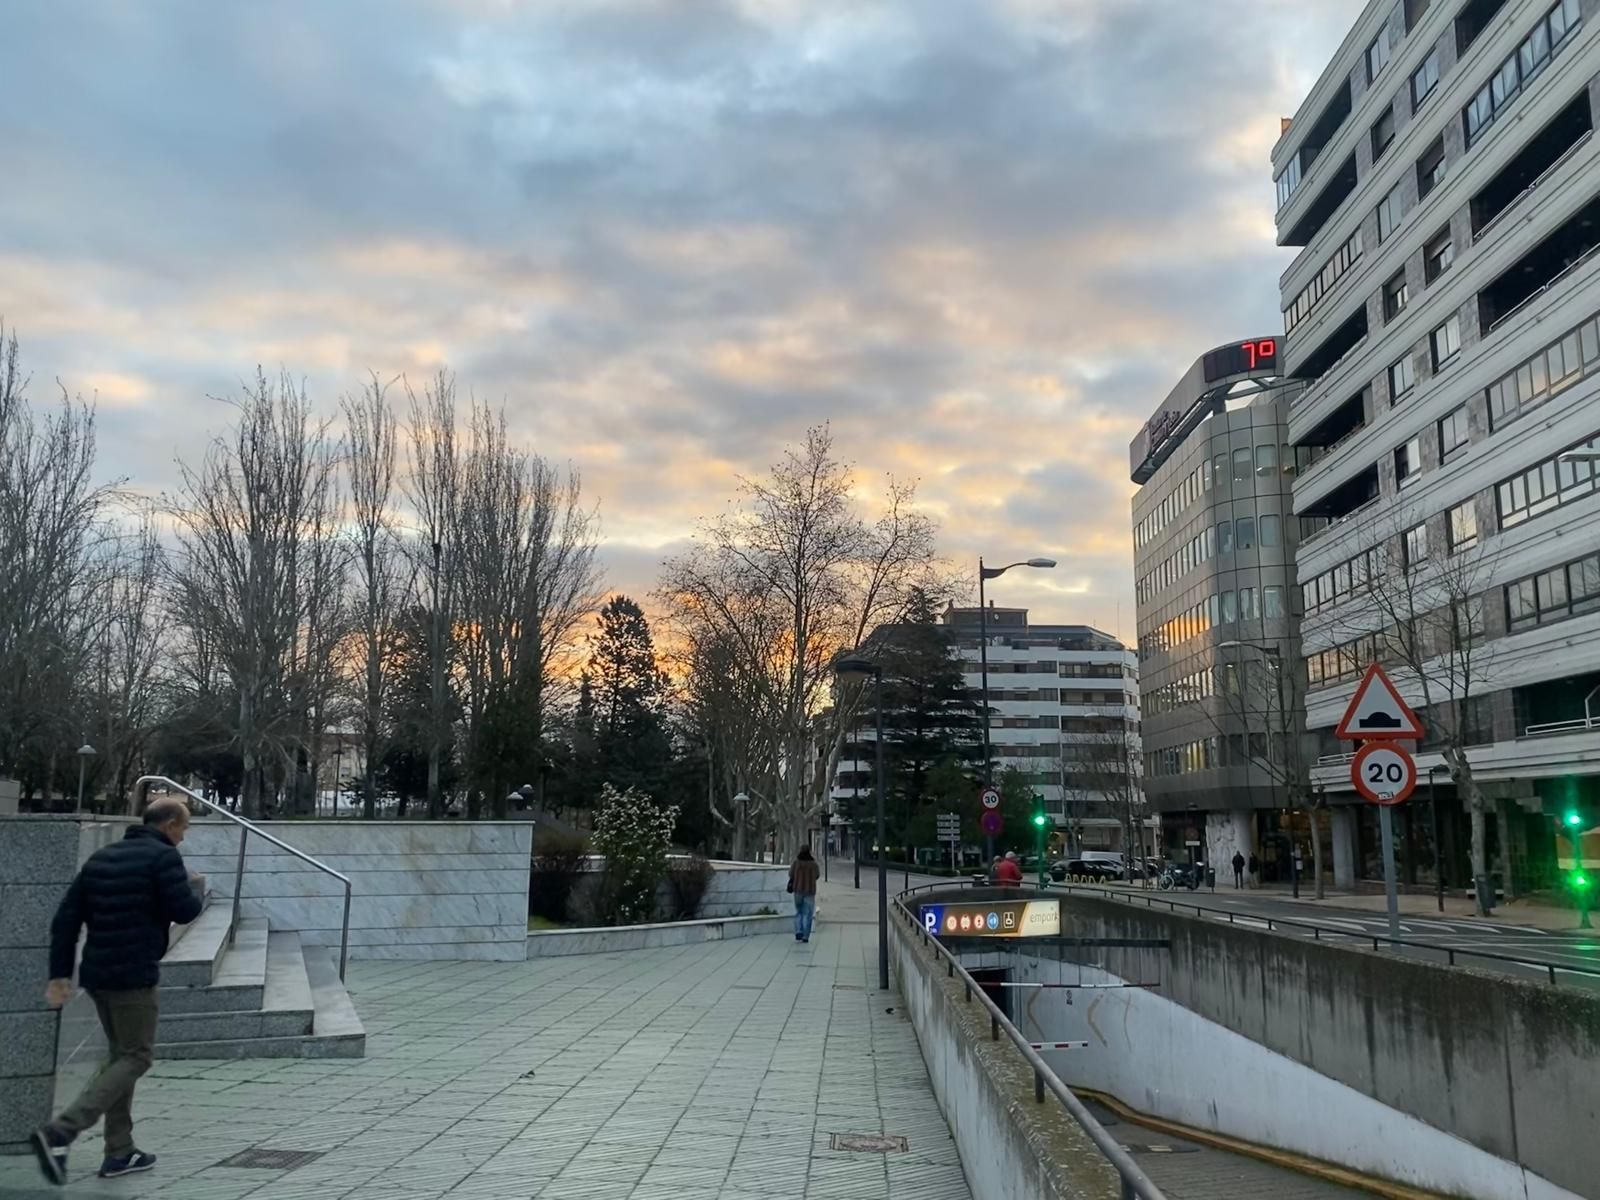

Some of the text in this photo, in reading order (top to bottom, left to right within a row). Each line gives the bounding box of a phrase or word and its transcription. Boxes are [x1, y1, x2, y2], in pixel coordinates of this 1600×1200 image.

[1368, 763, 1403, 783] 20
[985, 795, 997, 804] 30
[925, 912, 937, 932] P
